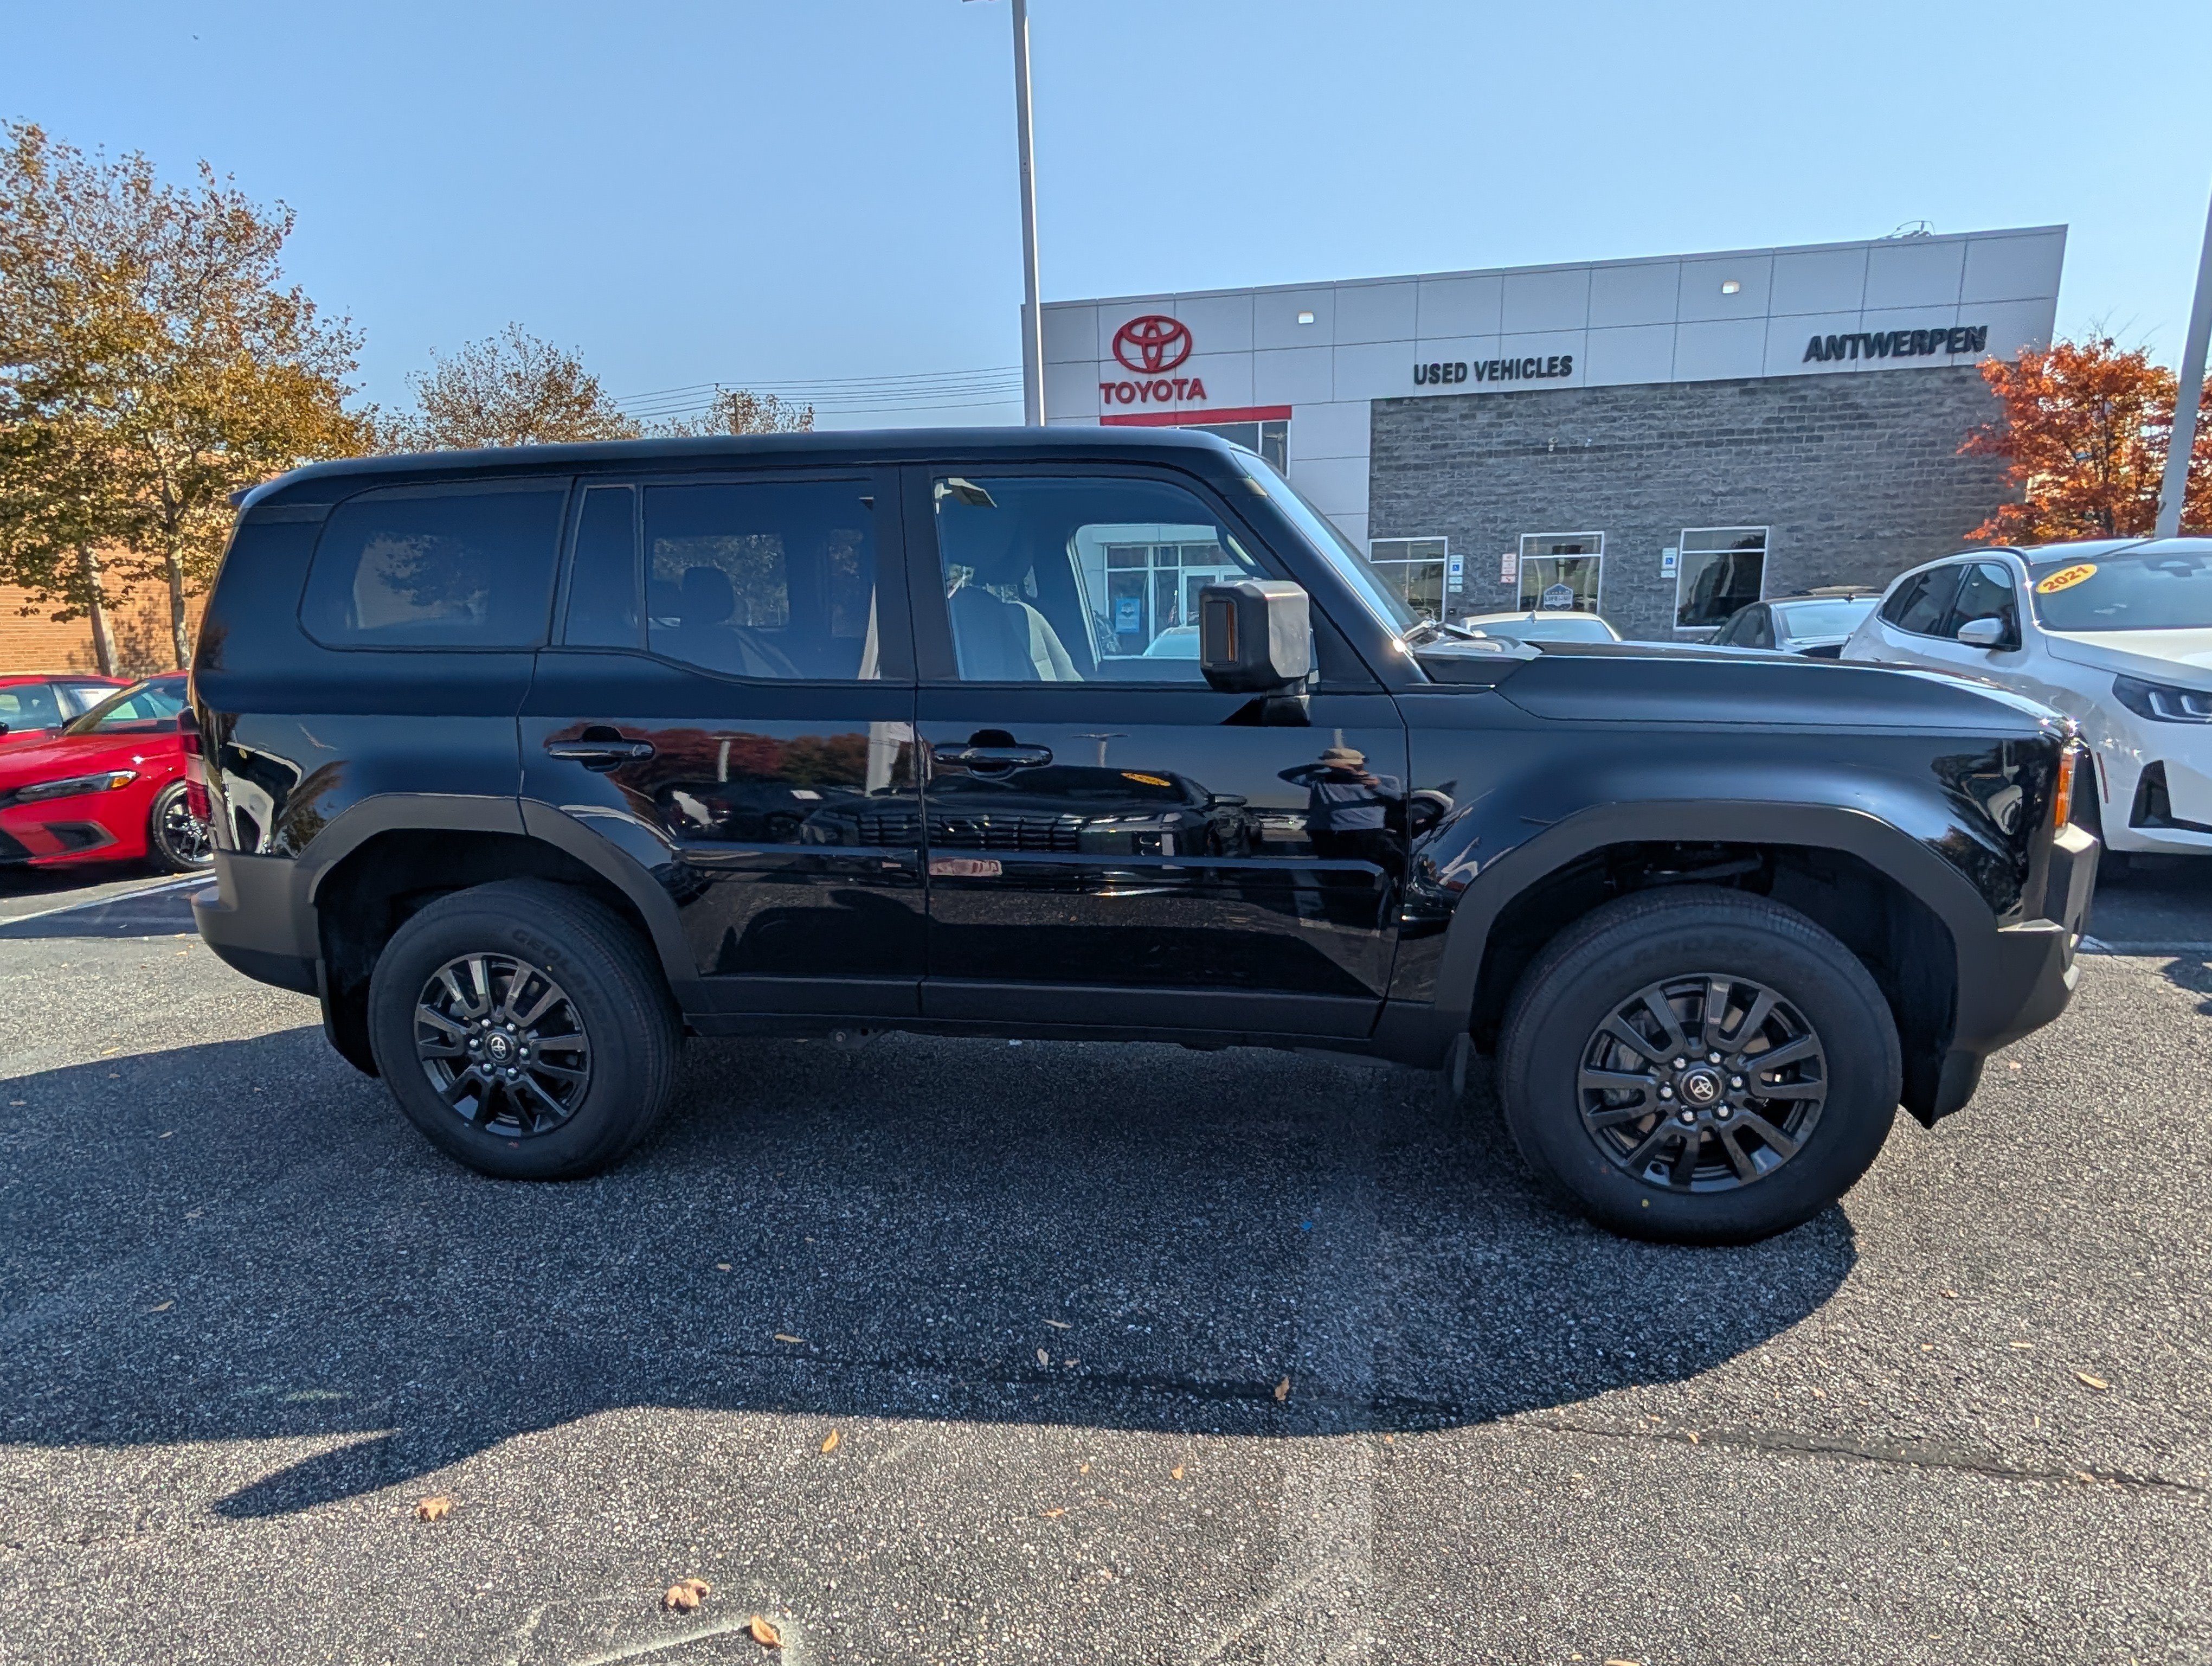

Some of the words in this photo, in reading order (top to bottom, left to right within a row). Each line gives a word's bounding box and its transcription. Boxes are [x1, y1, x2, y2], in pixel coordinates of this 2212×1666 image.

[1803, 325, 1988, 363] ANTWERPEN
[1414, 363, 1467, 385] USED
[1474, 355, 1573, 381] VEHICLES
[1099, 378, 1206, 404] TOYOTA
[2043, 567, 2088, 590] 2021
